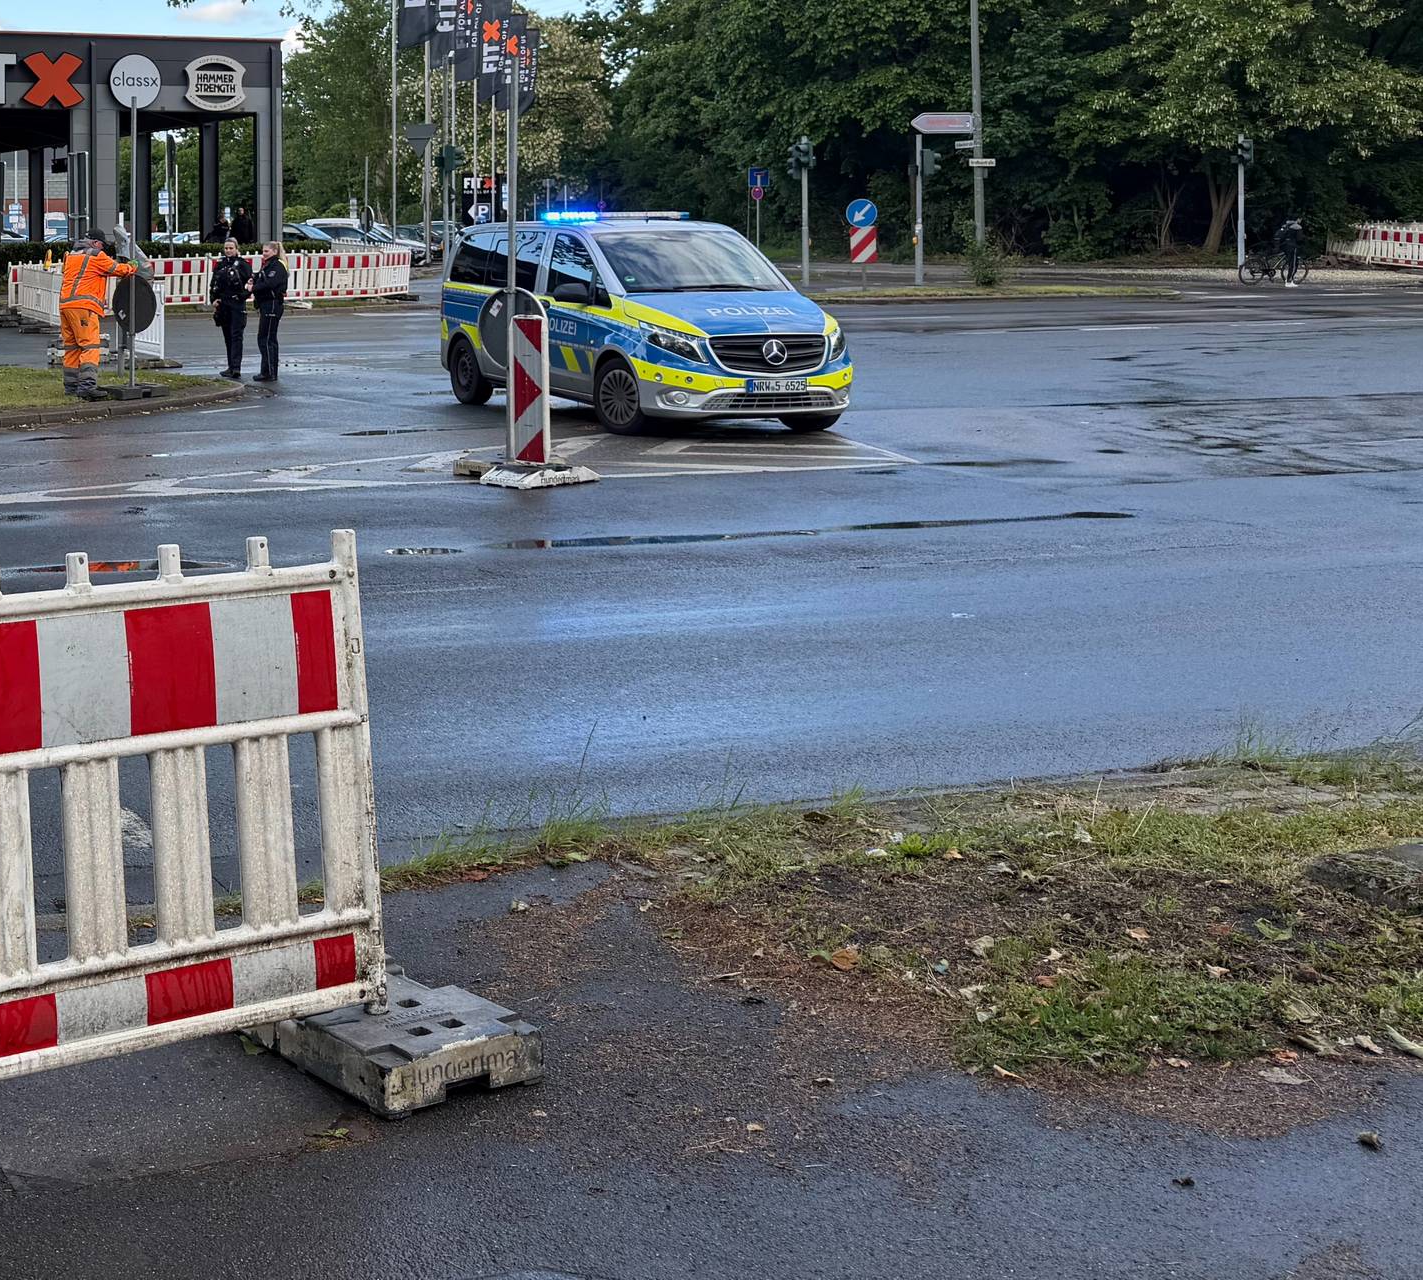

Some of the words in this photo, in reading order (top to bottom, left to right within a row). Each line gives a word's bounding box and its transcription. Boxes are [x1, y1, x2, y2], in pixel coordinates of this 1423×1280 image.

[482, 19, 501, 74] FITX
[112, 71, 159, 88] classx
[196, 73, 234, 83] HAMMER
[195, 84, 236, 93] STRENGTH
[478, 205, 489, 217] P
[704, 306, 797, 317] POLIZEI
[753, 380, 771, 392] NRW
